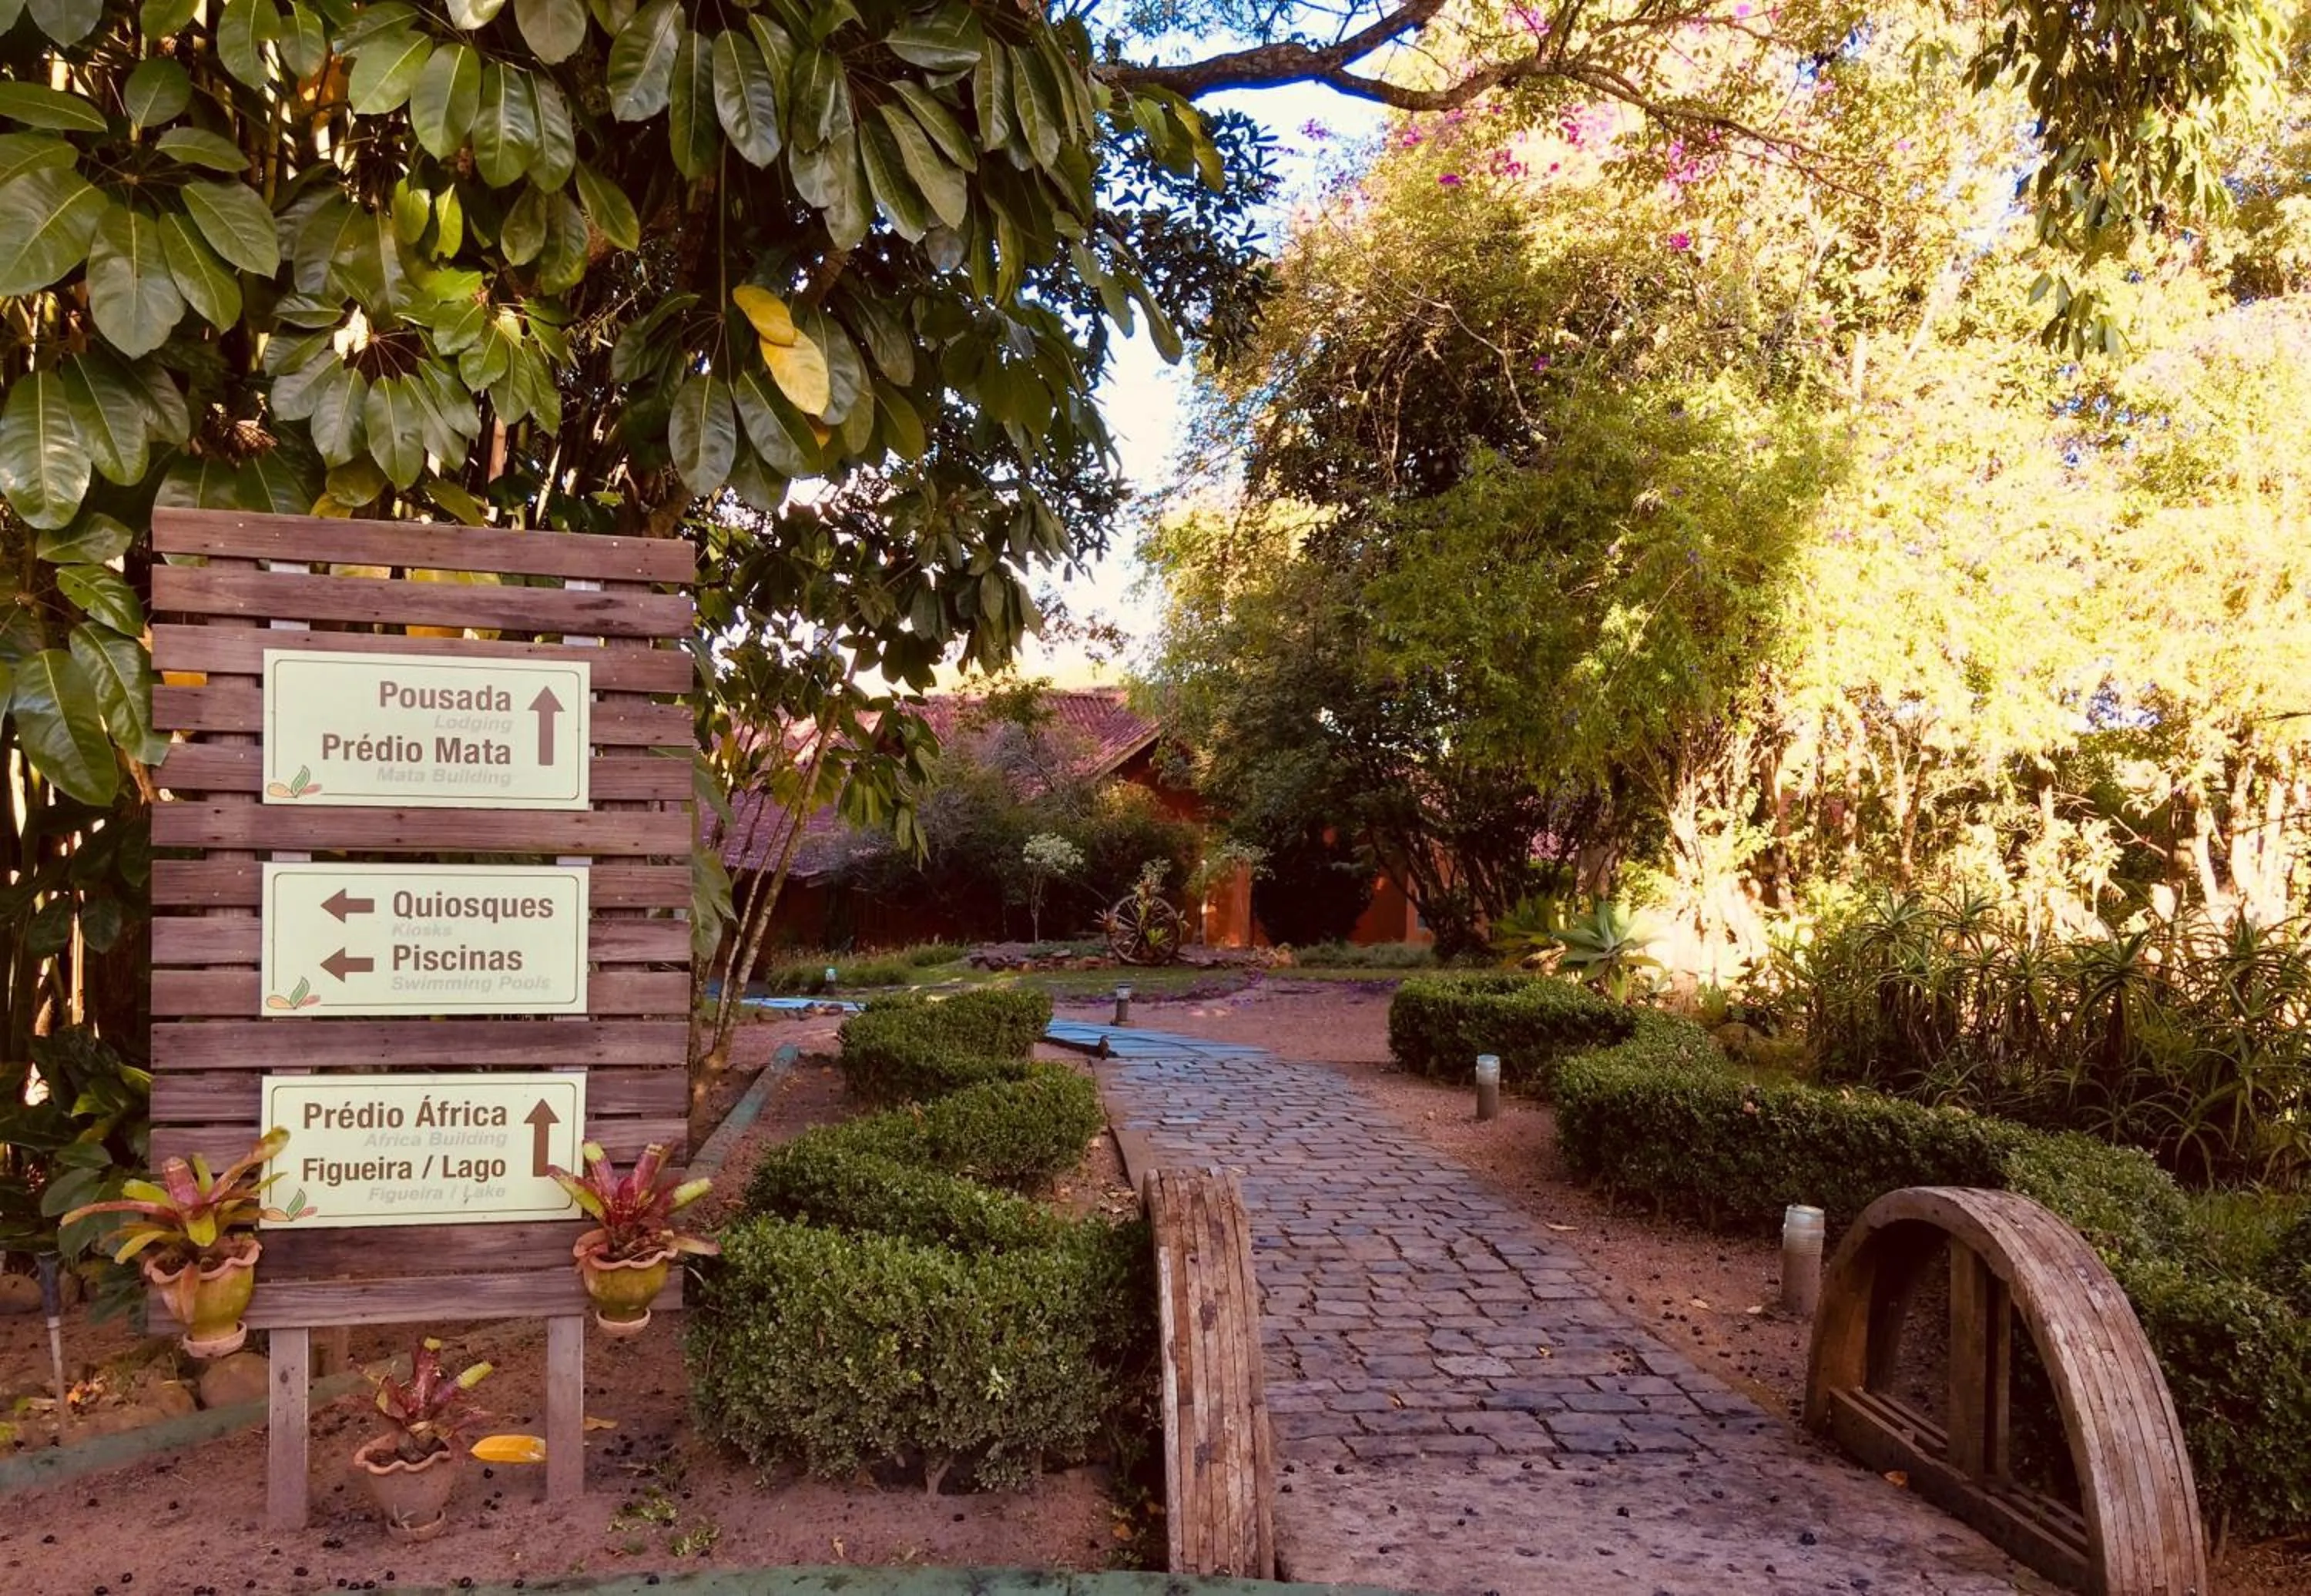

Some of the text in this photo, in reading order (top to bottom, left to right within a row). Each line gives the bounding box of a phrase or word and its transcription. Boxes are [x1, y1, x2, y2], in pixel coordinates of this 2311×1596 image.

[379, 681, 512, 712] Pousada
[434, 714, 513, 733] Lodging
[322, 733, 512, 765] Prédio Mata
[377, 767, 512, 786] Mata Building
[393, 890, 554, 924] Quiosques
[391, 924, 453, 937] Kiosks
[392, 944, 523, 971] Piscinas
[391, 975, 552, 993] Swimming Pools
[304, 1095, 508, 1129] Prédio África
[364, 1131, 508, 1148] Africa Building
[303, 1155, 507, 1187] Figueira / Lago
[367, 1184, 506, 1203] Figueira / Lake
